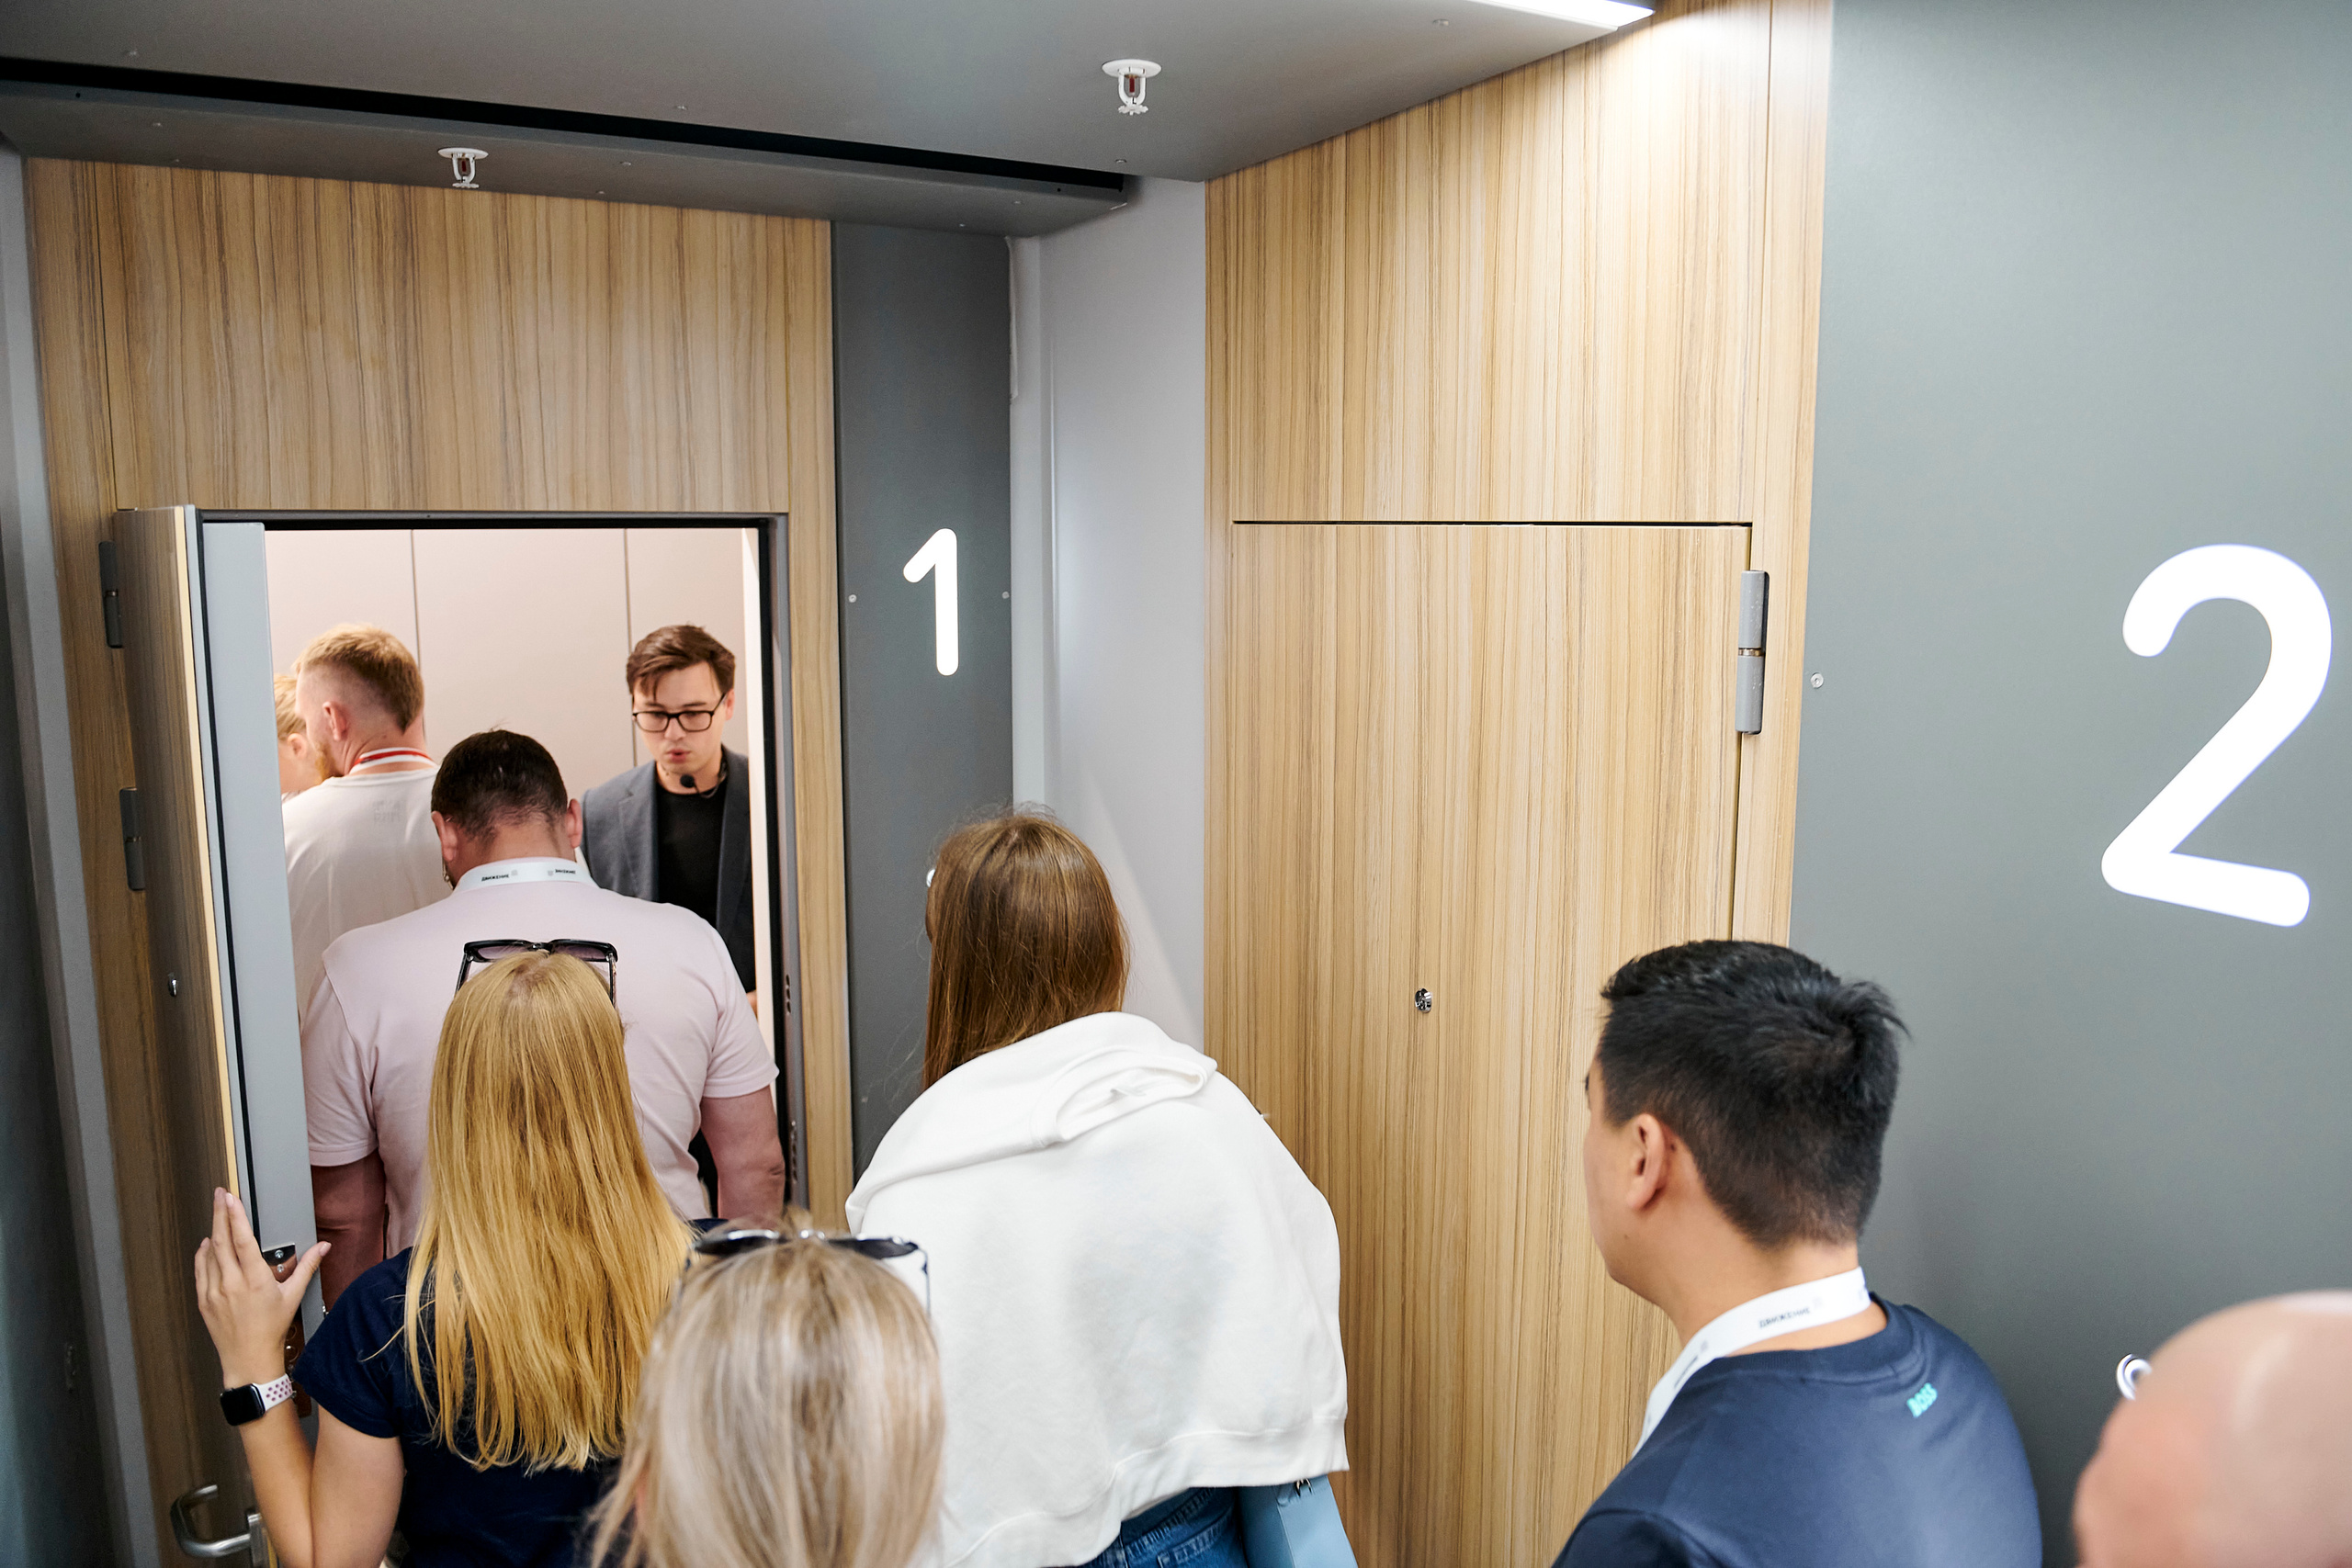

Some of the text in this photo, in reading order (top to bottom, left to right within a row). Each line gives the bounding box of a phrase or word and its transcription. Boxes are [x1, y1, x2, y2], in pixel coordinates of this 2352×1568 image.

[903, 528, 958, 676] 1
[2102, 544, 2332, 927] 2
[1758, 1306, 1811, 1328] ДВИЖЕНИЕ
